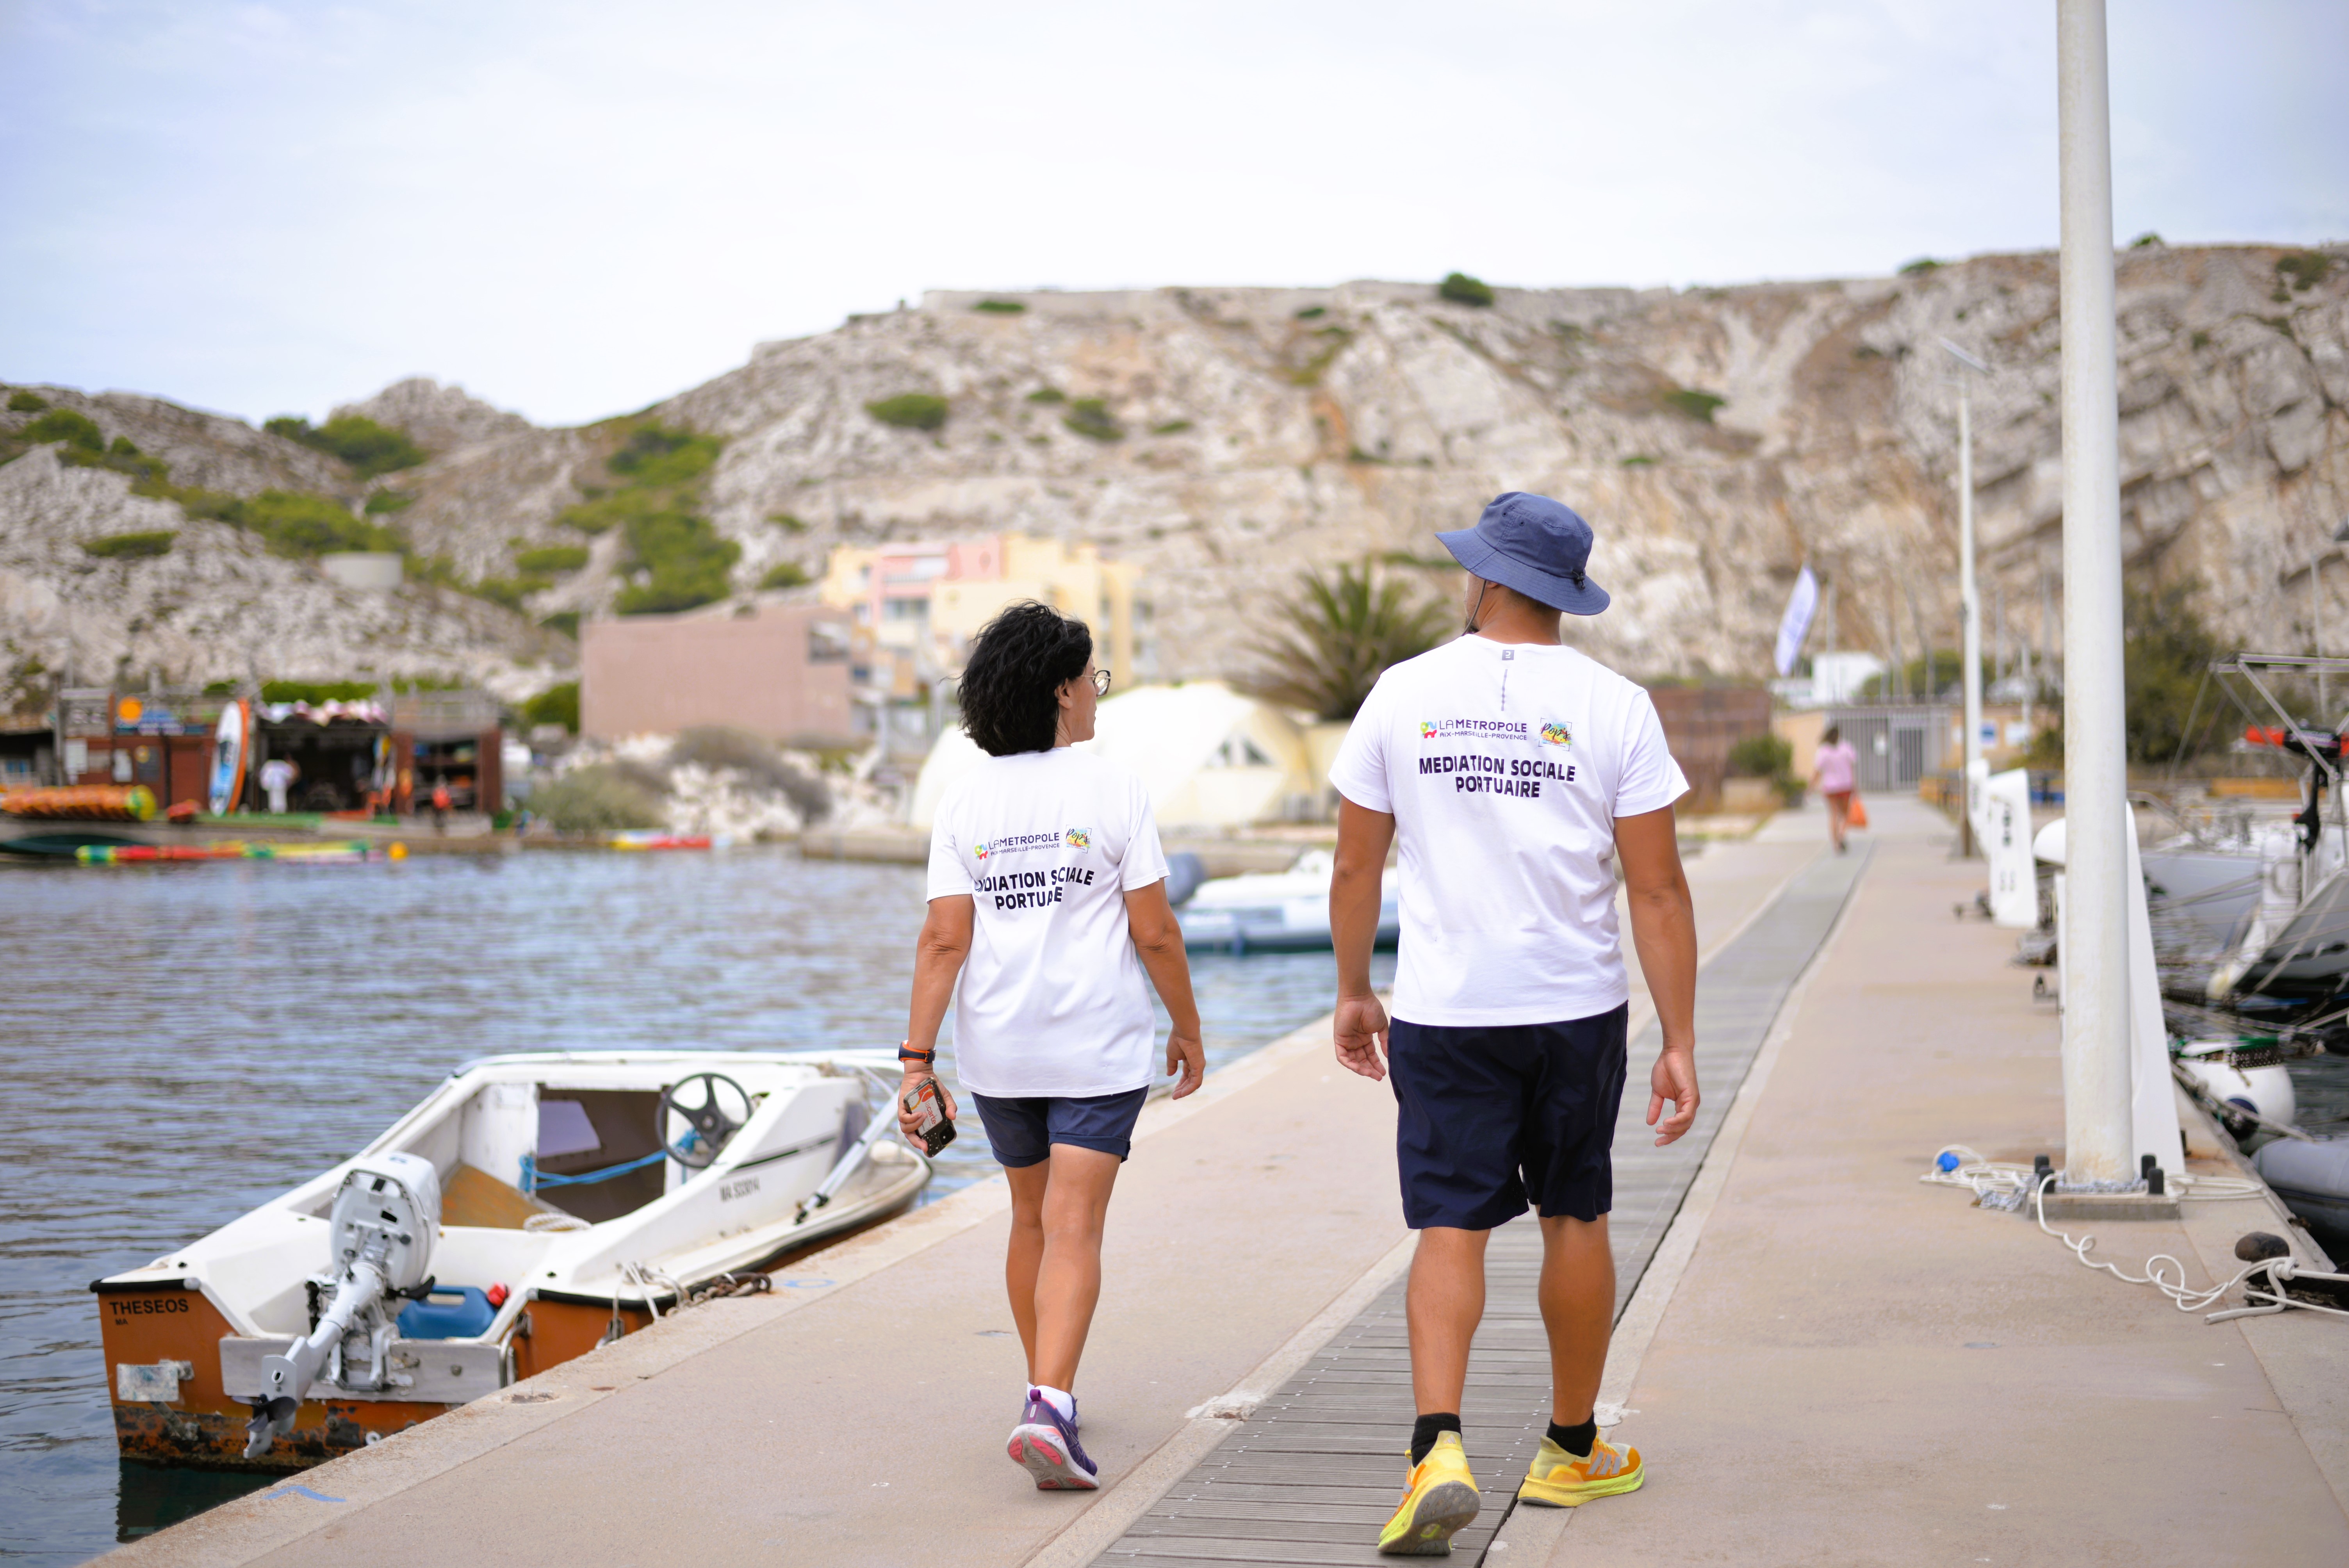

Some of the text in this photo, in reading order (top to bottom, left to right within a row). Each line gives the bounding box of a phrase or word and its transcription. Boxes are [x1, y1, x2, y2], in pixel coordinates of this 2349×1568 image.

[1541, 723, 1570, 740] Pop's
[1419, 755, 1576, 781] MEDIATION SOCIALE
[1455, 776, 1540, 798] PORTUAIRE
[1066, 828, 1090, 843] Pop's
[975, 867, 1094, 893] DIATION SCIALE
[994, 886, 1062, 910] PORTUAE
[109, 1299, 189, 1315] THESEOS
